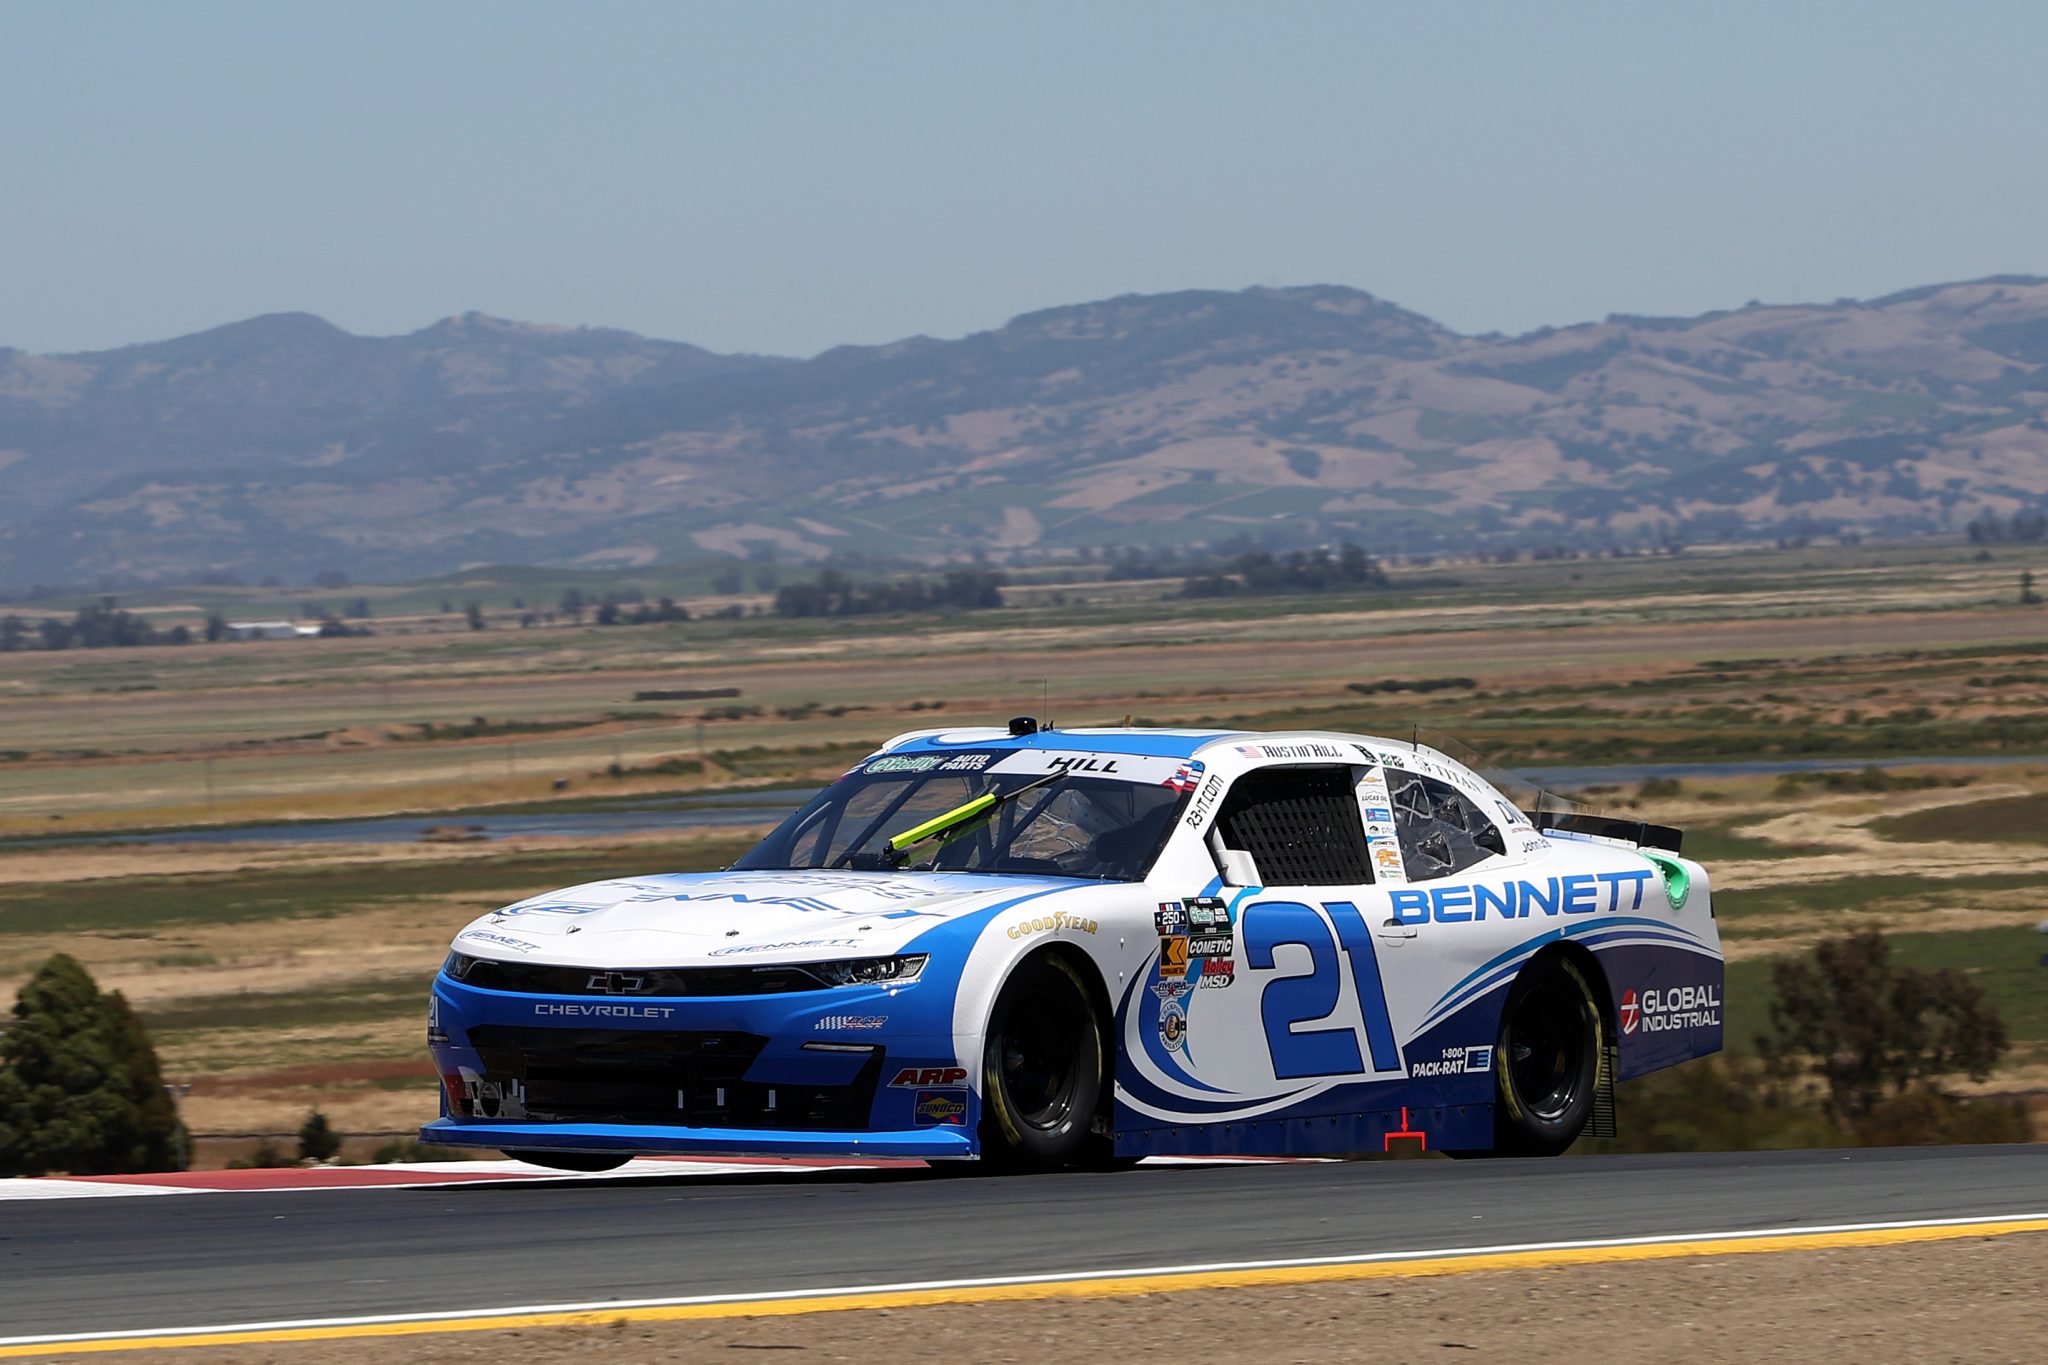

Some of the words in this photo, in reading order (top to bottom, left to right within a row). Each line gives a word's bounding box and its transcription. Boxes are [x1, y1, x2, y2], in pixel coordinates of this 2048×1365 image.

[951, 754, 991, 763] AUTO
[1307, 744, 1343, 758] HILL
[938, 762, 987, 770] PARTS
[1047, 757, 1119, 774] HILL
[1388, 869, 1654, 925] BENNETT
[1007, 911, 1099, 940] GOODYEAR
[1162, 911, 1180, 925] 250
[1203, 959, 1235, 976] Holley
[1200, 974, 1230, 989] MSD
[1242, 900, 1402, 1080] 21
[1642, 984, 1720, 1014] GLOBAL
[534, 1003, 675, 1019] CHEVROLET
[1642, 1010, 1720, 1033] INDUSTRIAL
[1442, 1048, 1465, 1058] 1-800-
[893, 1068, 968, 1085] ARP
[918, 1103, 964, 1113] SUNOCO
